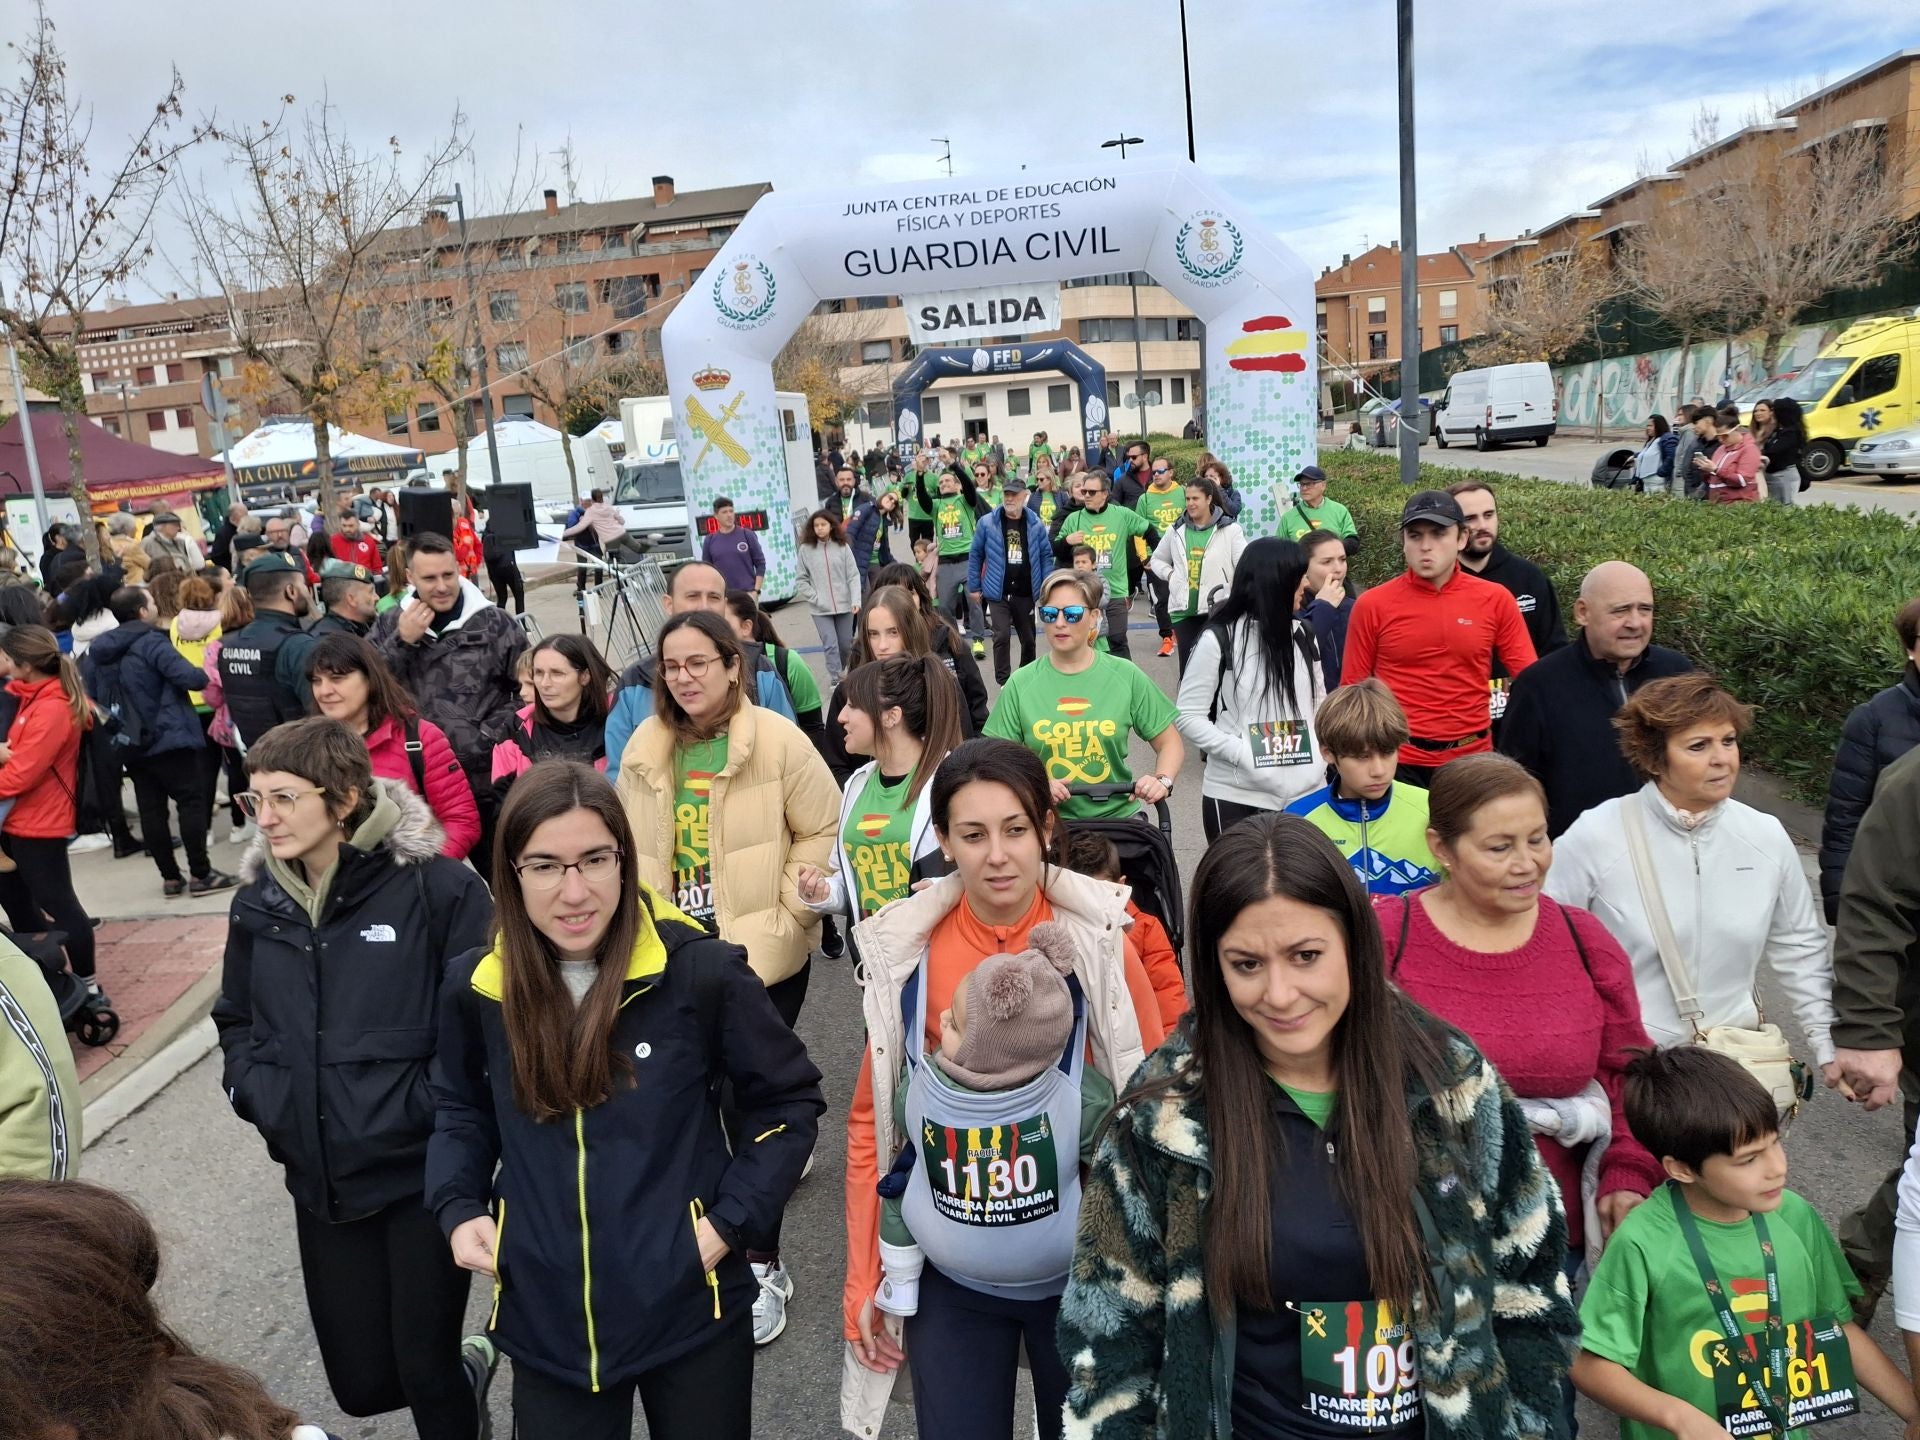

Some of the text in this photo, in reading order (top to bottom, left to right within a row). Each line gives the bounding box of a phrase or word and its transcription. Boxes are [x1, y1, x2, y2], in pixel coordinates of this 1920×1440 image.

[842, 176, 1116, 216] JUNTA CENTRAL DE EDUCACIÓN
[897, 202, 1061, 233] FÍSICA Y DEPORTES
[844, 226, 1120, 277] GUARDIA CIVIL
[1182, 269, 1244, 289] GUARDIA CIVIL
[717, 311, 777, 331] GUARDIA CIVIL
[920, 296, 1046, 331] SALIDA
[993, 349, 1022, 364] FFD
[898, 442, 921, 456] FFD
[257, 463, 297, 482] CIVIL
[348, 455, 407, 472] GUARDIA CIVIL
[1153, 508, 1183, 517] Corre
[1083, 533, 1117, 542] Corre
[222, 648, 261, 661] GUARDIA
[229, 662, 252, 675] CIVIL
[1032, 719, 1116, 741] Corre
[1044, 735, 1105, 758] TEA
[1261, 734, 1302, 754] 1347
[856, 861, 910, 890] TEA
[967, 1148, 1002, 1158] RAQUEL
[940, 1154, 1038, 1198] 1130
[937, 1189, 1054, 1211] CARRERA SOLIDARIA
[938, 1203, 1054, 1223] GUARDIA CIVIL LA RIOJA
[1380, 1324, 1410, 1339] MARIA
[1333, 1339, 1419, 1395] 109
[1318, 1395, 1392, 1412] CARRERA
[1731, 1409, 1767, 1424] CARR
[1790, 1388, 1854, 1414] SOLIDARIA
[1318, 1406, 1420, 1427] GUARDIA CIVIL
[1787, 1412, 1817, 1427] CIVIL
[1821, 1409, 1831, 1418] LA
[1831, 1403, 1854, 1416] RIOJA
